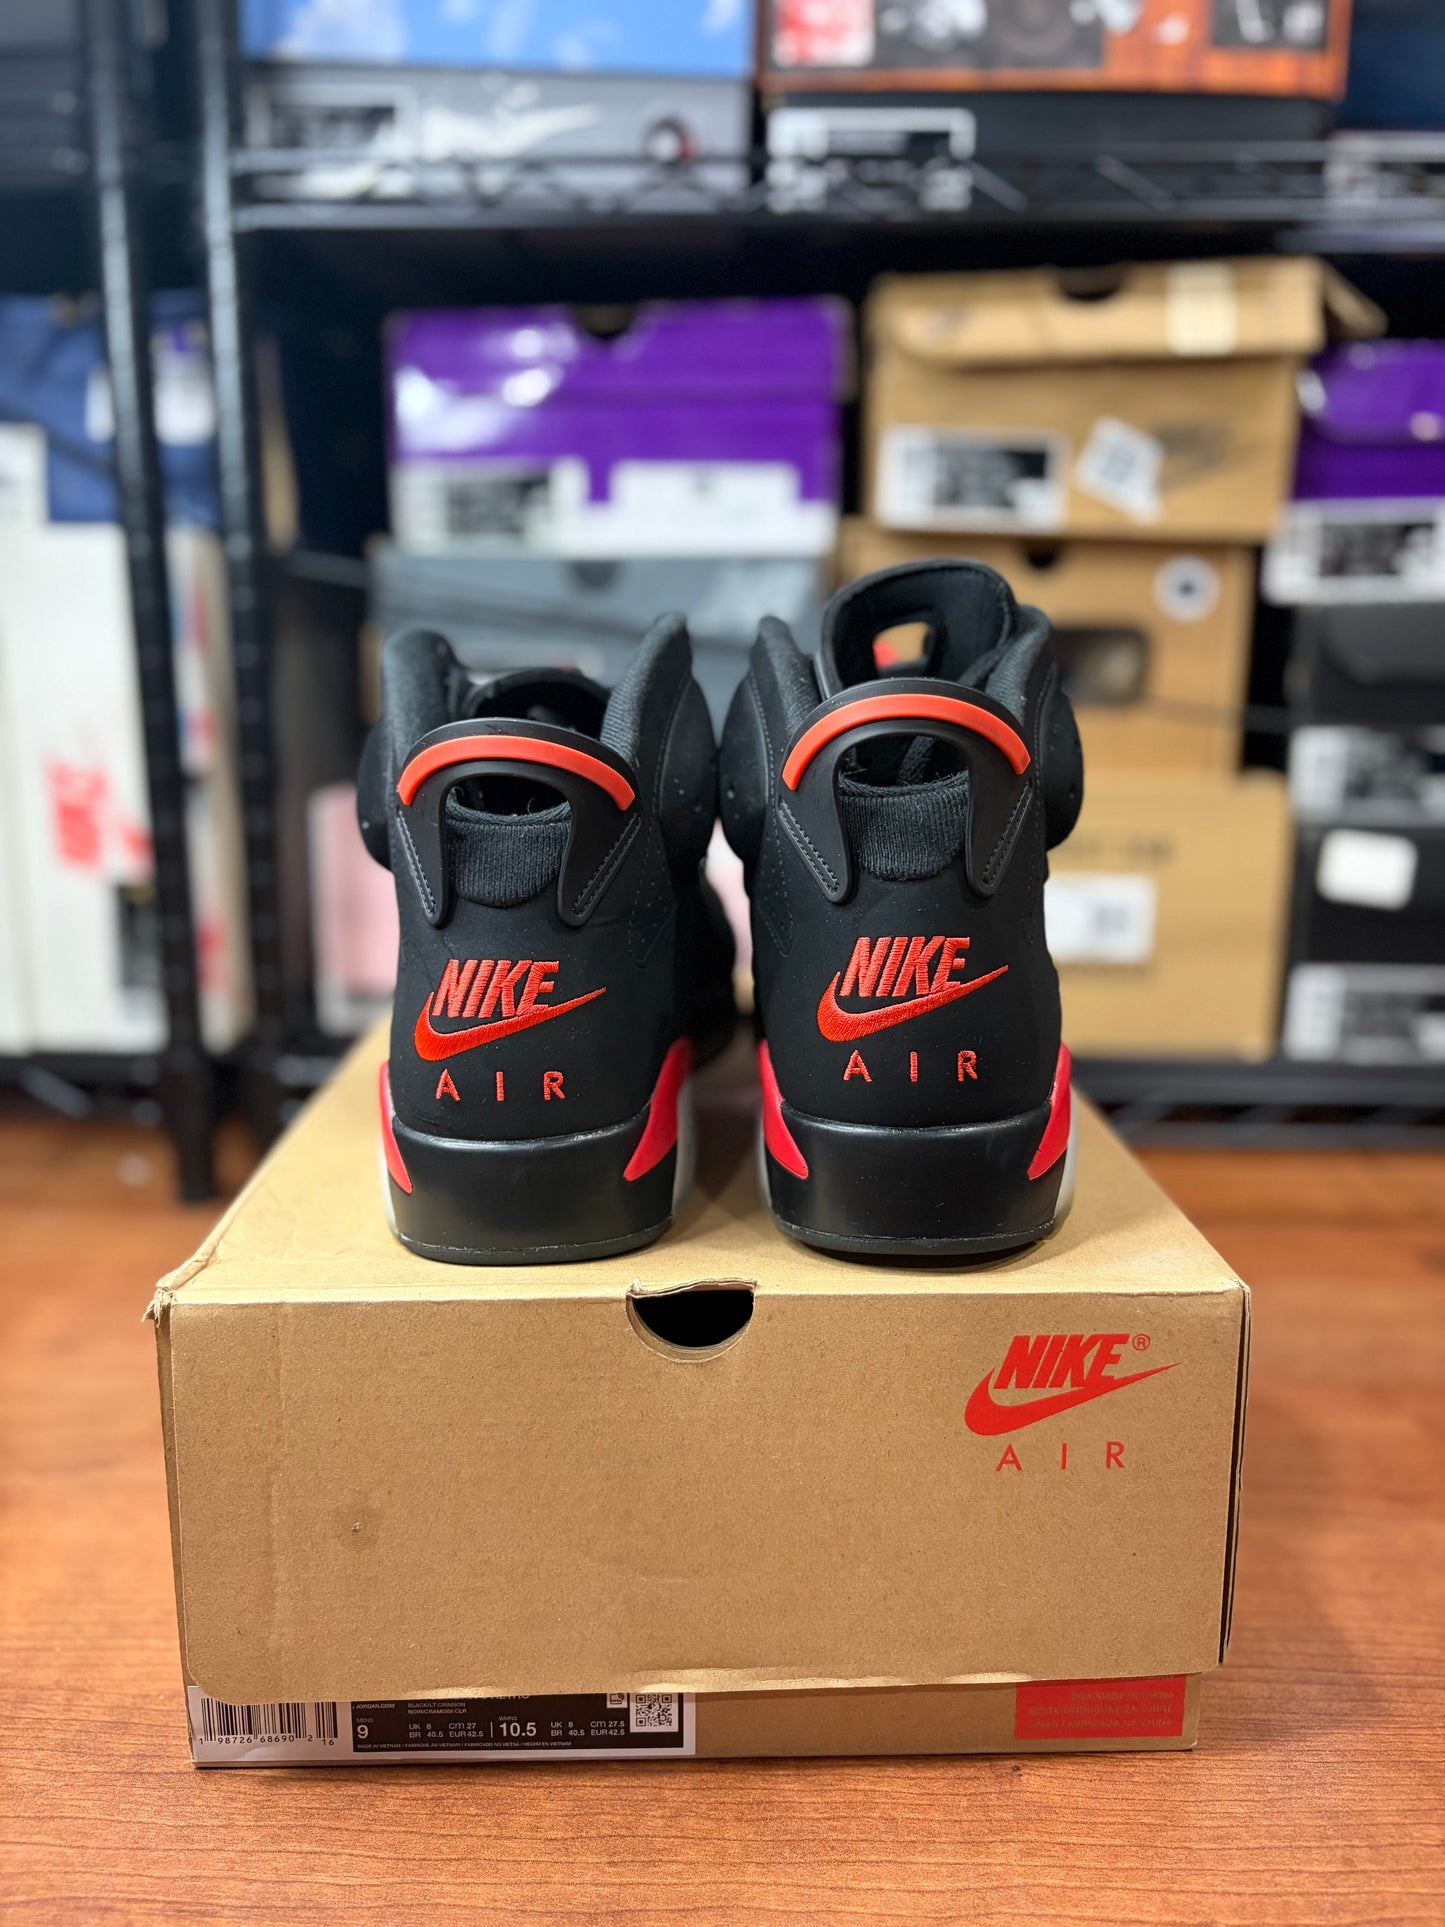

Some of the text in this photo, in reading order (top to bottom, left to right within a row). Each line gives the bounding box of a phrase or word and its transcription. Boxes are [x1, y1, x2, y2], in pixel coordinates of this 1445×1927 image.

[839, 936, 970, 997] NIKE
[431, 958, 559, 1019] NIKE
[842, 1049, 978, 1082] AIR
[435, 1068, 566, 1102] AIR
[996, 1441, 1126, 1472] AIR
[1141, 1690, 1174, 1699] CHINA
[218, 1736, 253, 1744] 98726
[260, 1735, 295, 1743] 68690
[356, 1724, 369, 1740] 9
[499, 1722, 537, 1737] 10.5
